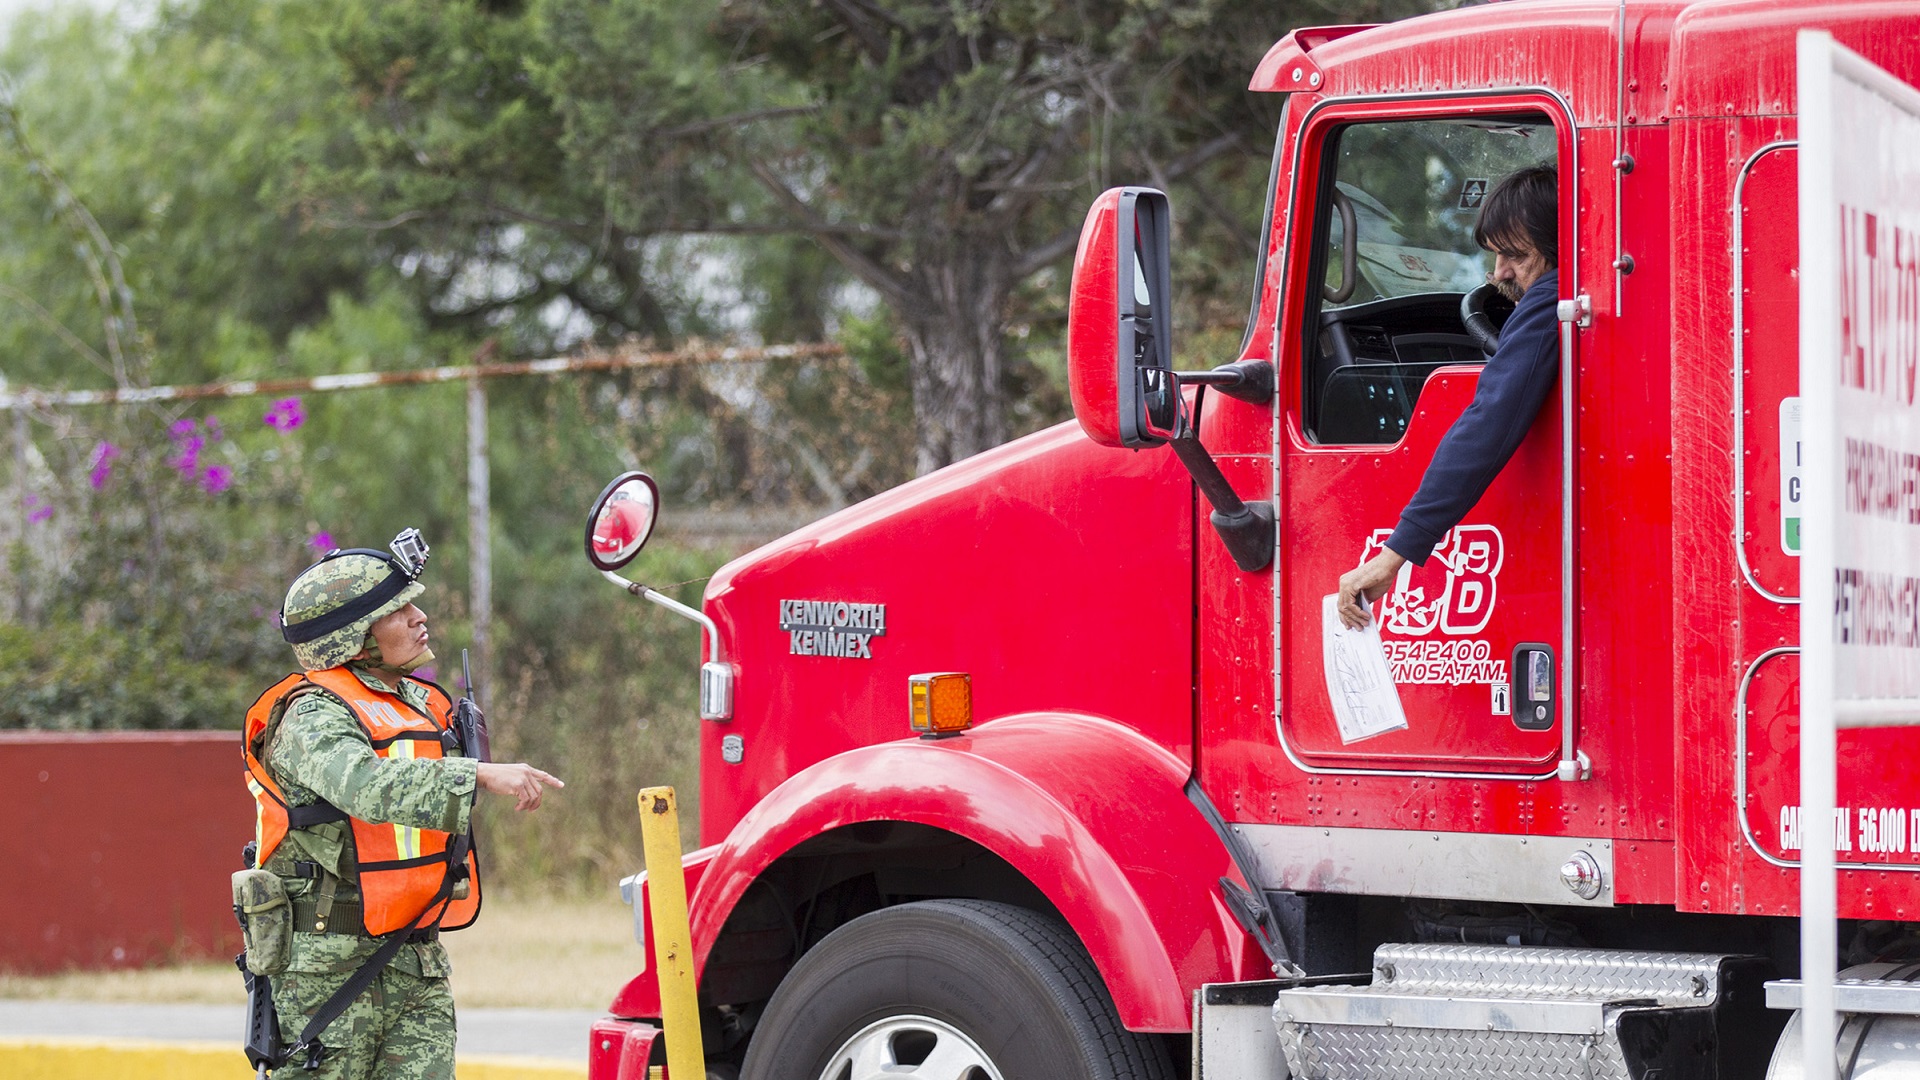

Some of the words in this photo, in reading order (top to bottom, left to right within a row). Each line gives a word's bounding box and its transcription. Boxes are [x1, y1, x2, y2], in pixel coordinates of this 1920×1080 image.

[780, 599, 886, 628] KENWORTH
[790, 630, 872, 659] KENMEX
[1859, 807, 1906, 853] 56.000
